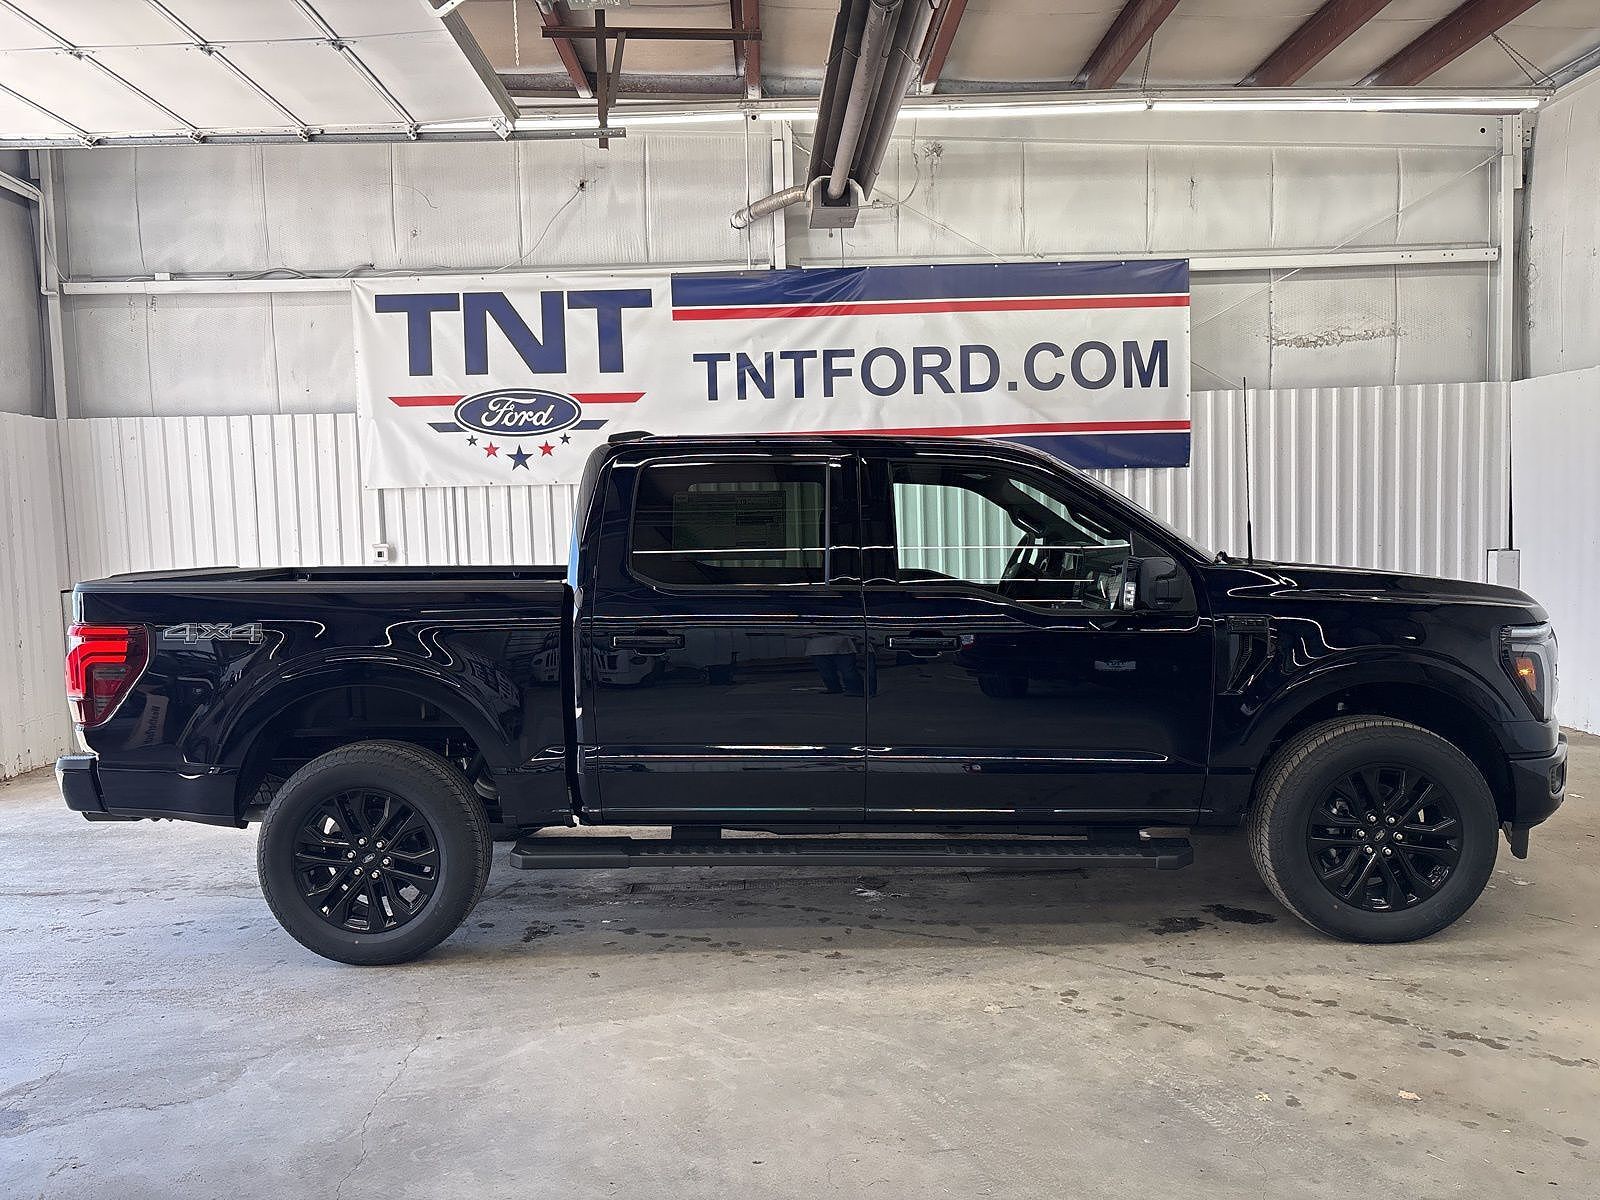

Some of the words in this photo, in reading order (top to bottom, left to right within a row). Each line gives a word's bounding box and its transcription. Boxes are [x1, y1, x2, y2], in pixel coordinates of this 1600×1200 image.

[374, 289, 653, 377] TNT
[693, 340, 1170, 401] TNTFORD.COM
[480, 396, 555, 428] Ford
